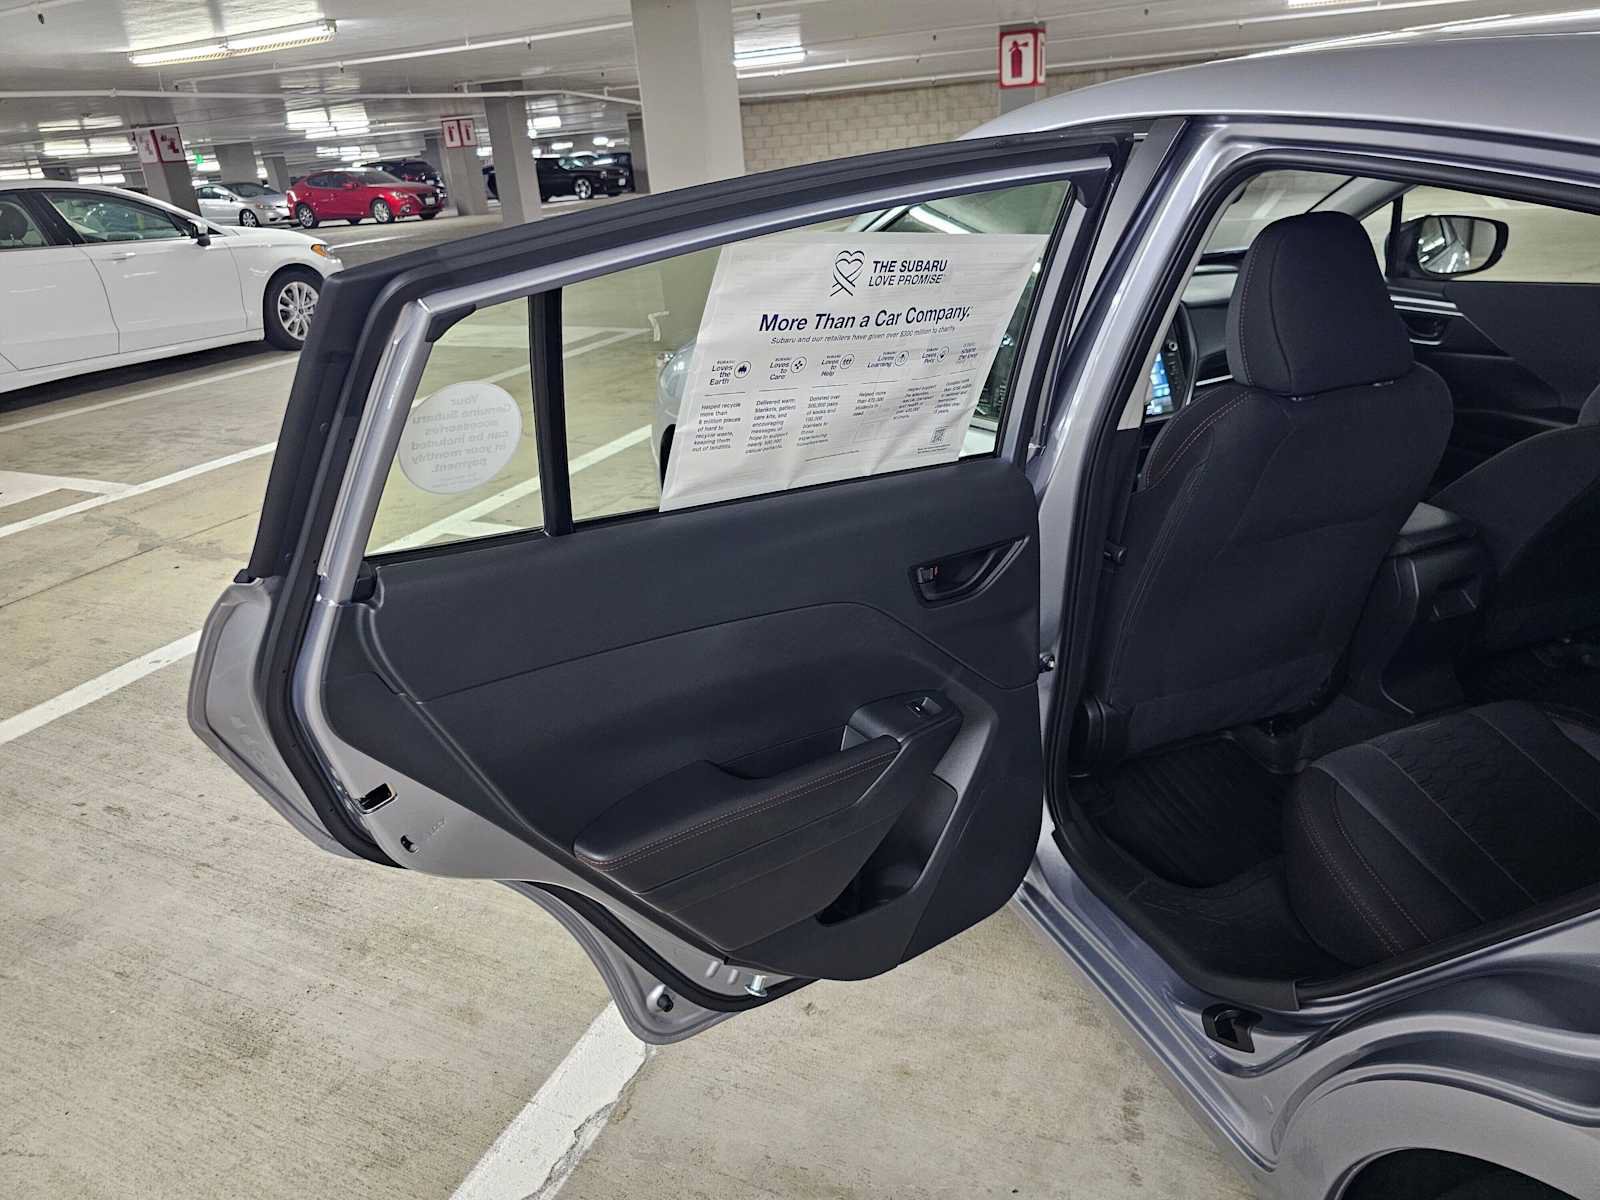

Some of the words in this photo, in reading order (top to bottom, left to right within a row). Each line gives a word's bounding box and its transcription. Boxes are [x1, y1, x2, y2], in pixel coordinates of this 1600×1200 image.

[872, 260, 895, 273] THE
[899, 259, 948, 273] SUBARU
[869, 275, 895, 287] LOVE
[897, 274, 943, 285] PROMISE
[759, 314, 808, 332] More
[814, 313, 856, 329] Than
[859, 315, 870, 328] a
[874, 310, 901, 327] Car
[905, 306, 971, 324] Company.
[770, 337, 796, 345] Subaru
[824, 333, 850, 342] retailers
[851, 333, 868, 341] have
[869, 333, 885, 341] given
